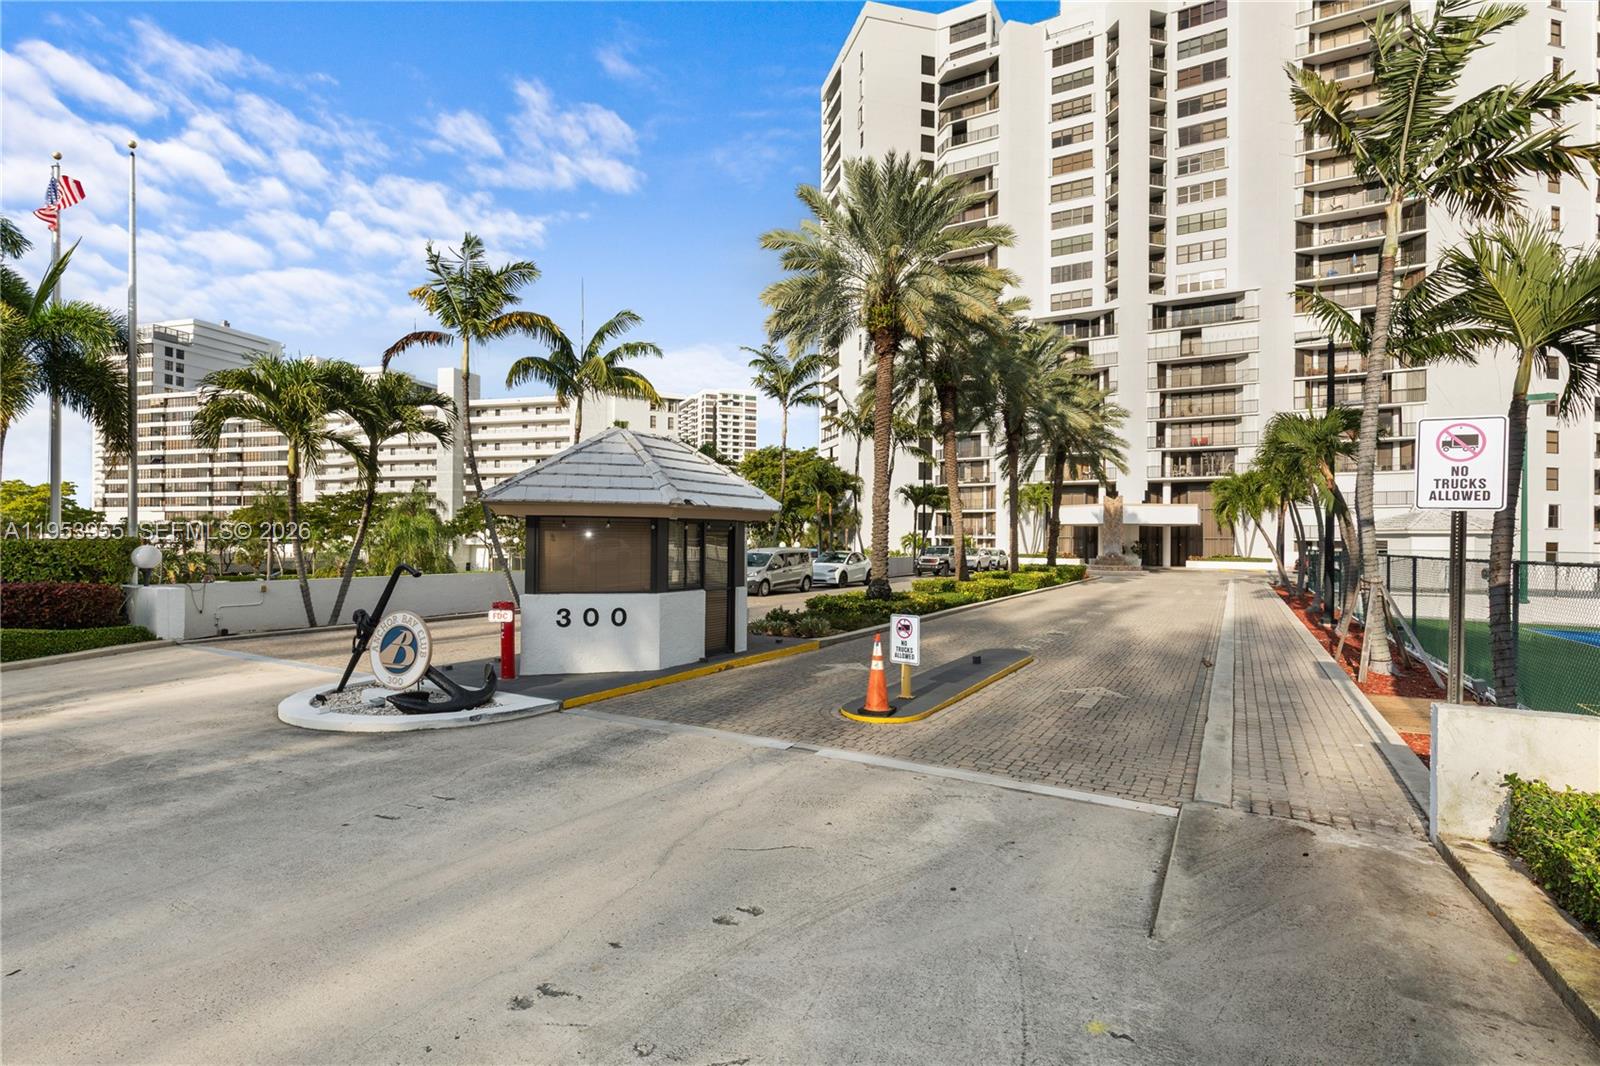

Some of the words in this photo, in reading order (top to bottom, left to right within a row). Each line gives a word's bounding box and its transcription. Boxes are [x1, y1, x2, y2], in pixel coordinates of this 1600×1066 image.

[1451, 466, 1469, 477] NO
[1433, 478, 1487, 489] TRUCKS
[1429, 490, 1491, 501] ALLOWED
[493, 612, 509, 620] FDC
[556, 607, 628, 628] 300
[371, 615, 398, 652] ANCHOR
[402, 614, 419, 627] BAY
[417, 630, 427, 658] CLUB
[896, 646, 914, 654] TRUCKS
[894, 652, 915, 660] ALLOWED
[387, 676, 404, 686] 300
